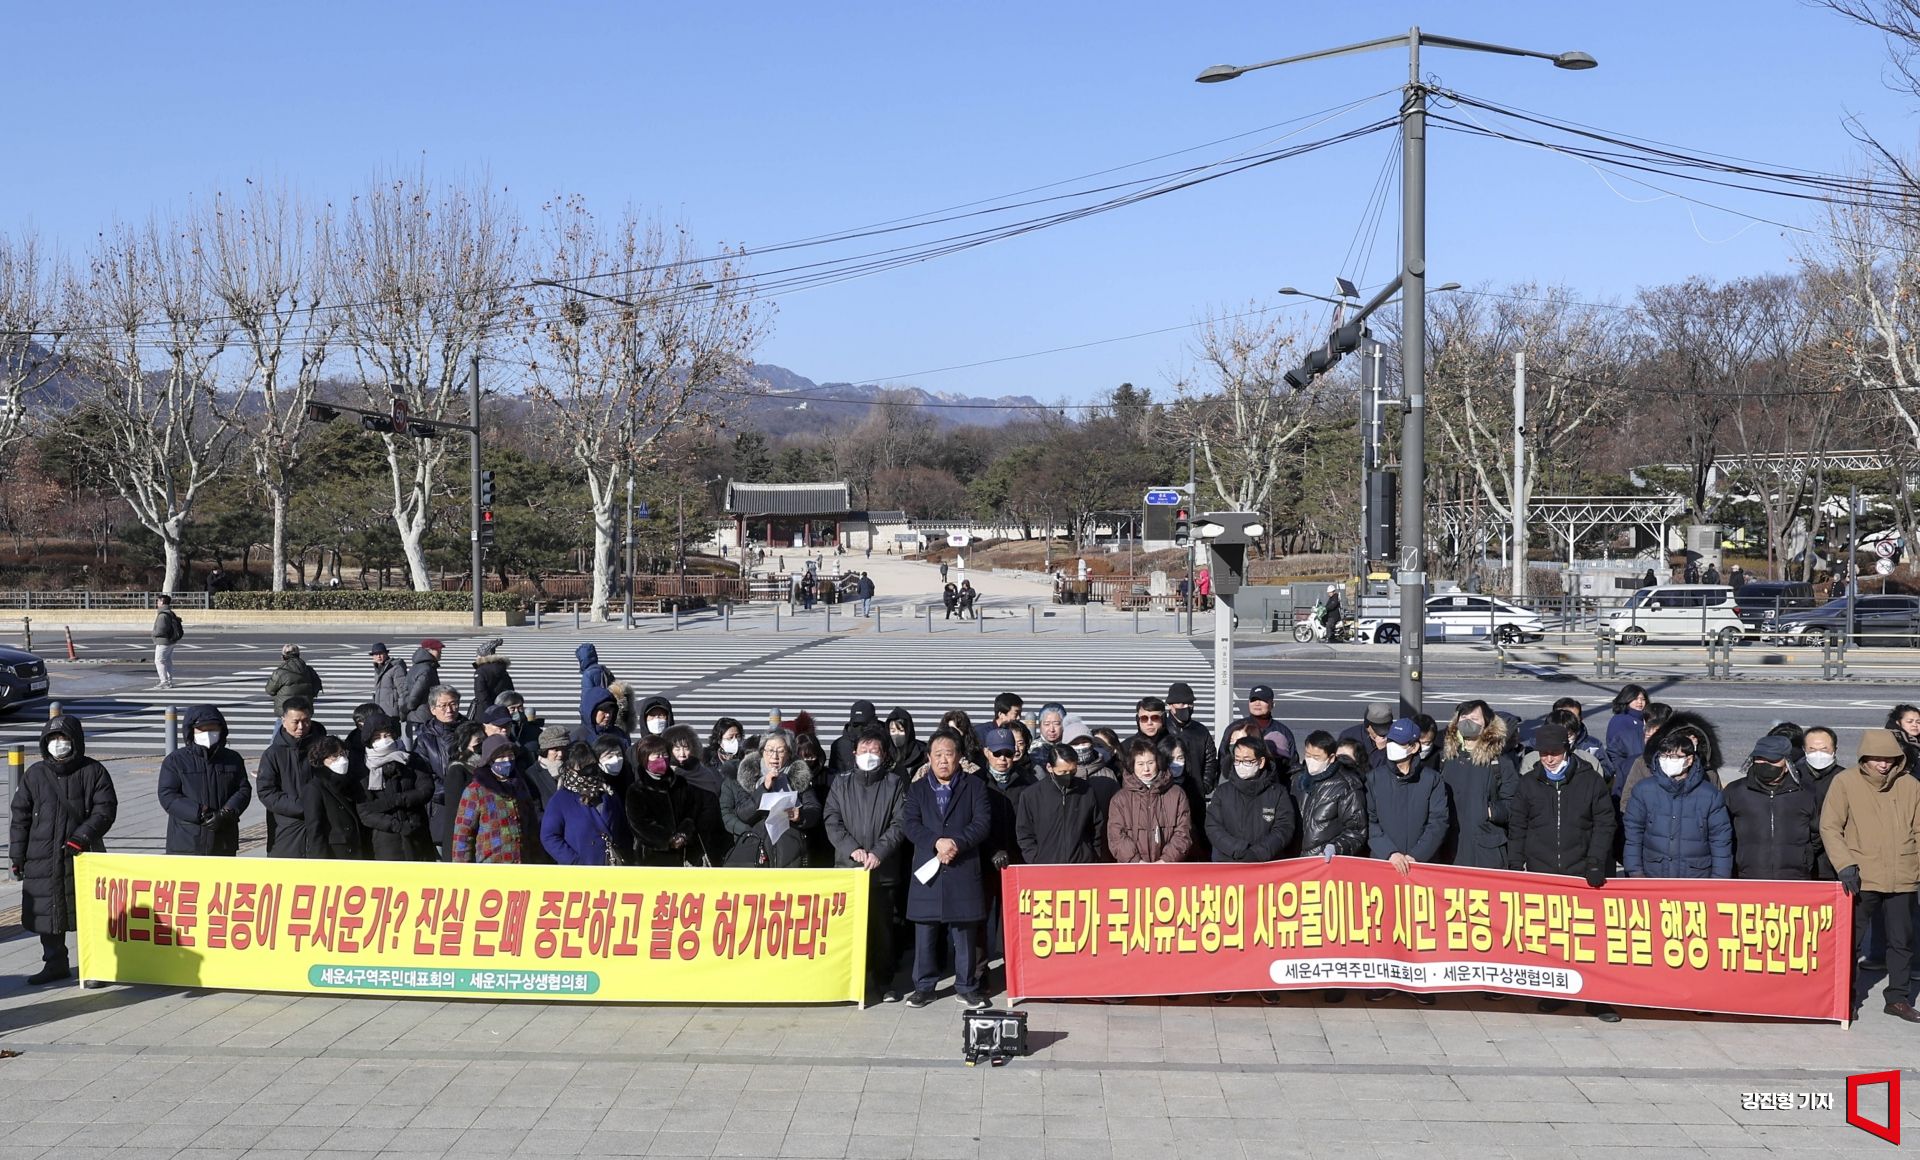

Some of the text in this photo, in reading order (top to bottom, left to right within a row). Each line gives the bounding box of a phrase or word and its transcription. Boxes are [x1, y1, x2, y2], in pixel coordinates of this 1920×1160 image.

[95, 877, 847, 961] “애드벌룬 실증이 무서운가? 진실 은폐 중단하고 촬영 허가하라!”
[1019, 879, 1835, 975] “종묘가 국사유산청의 사유물이냐? 시민 검증 가로막는 밀실 행정 규탄한다!”
[320, 968, 455, 988] 세운4구역주민대표회의
[469, 971, 588, 991] 세운지구상생협의회
[1284, 962, 1427, 983] 세운4구역주민대표회의
[1443, 965, 1570, 990] 세운지구상생협의회
